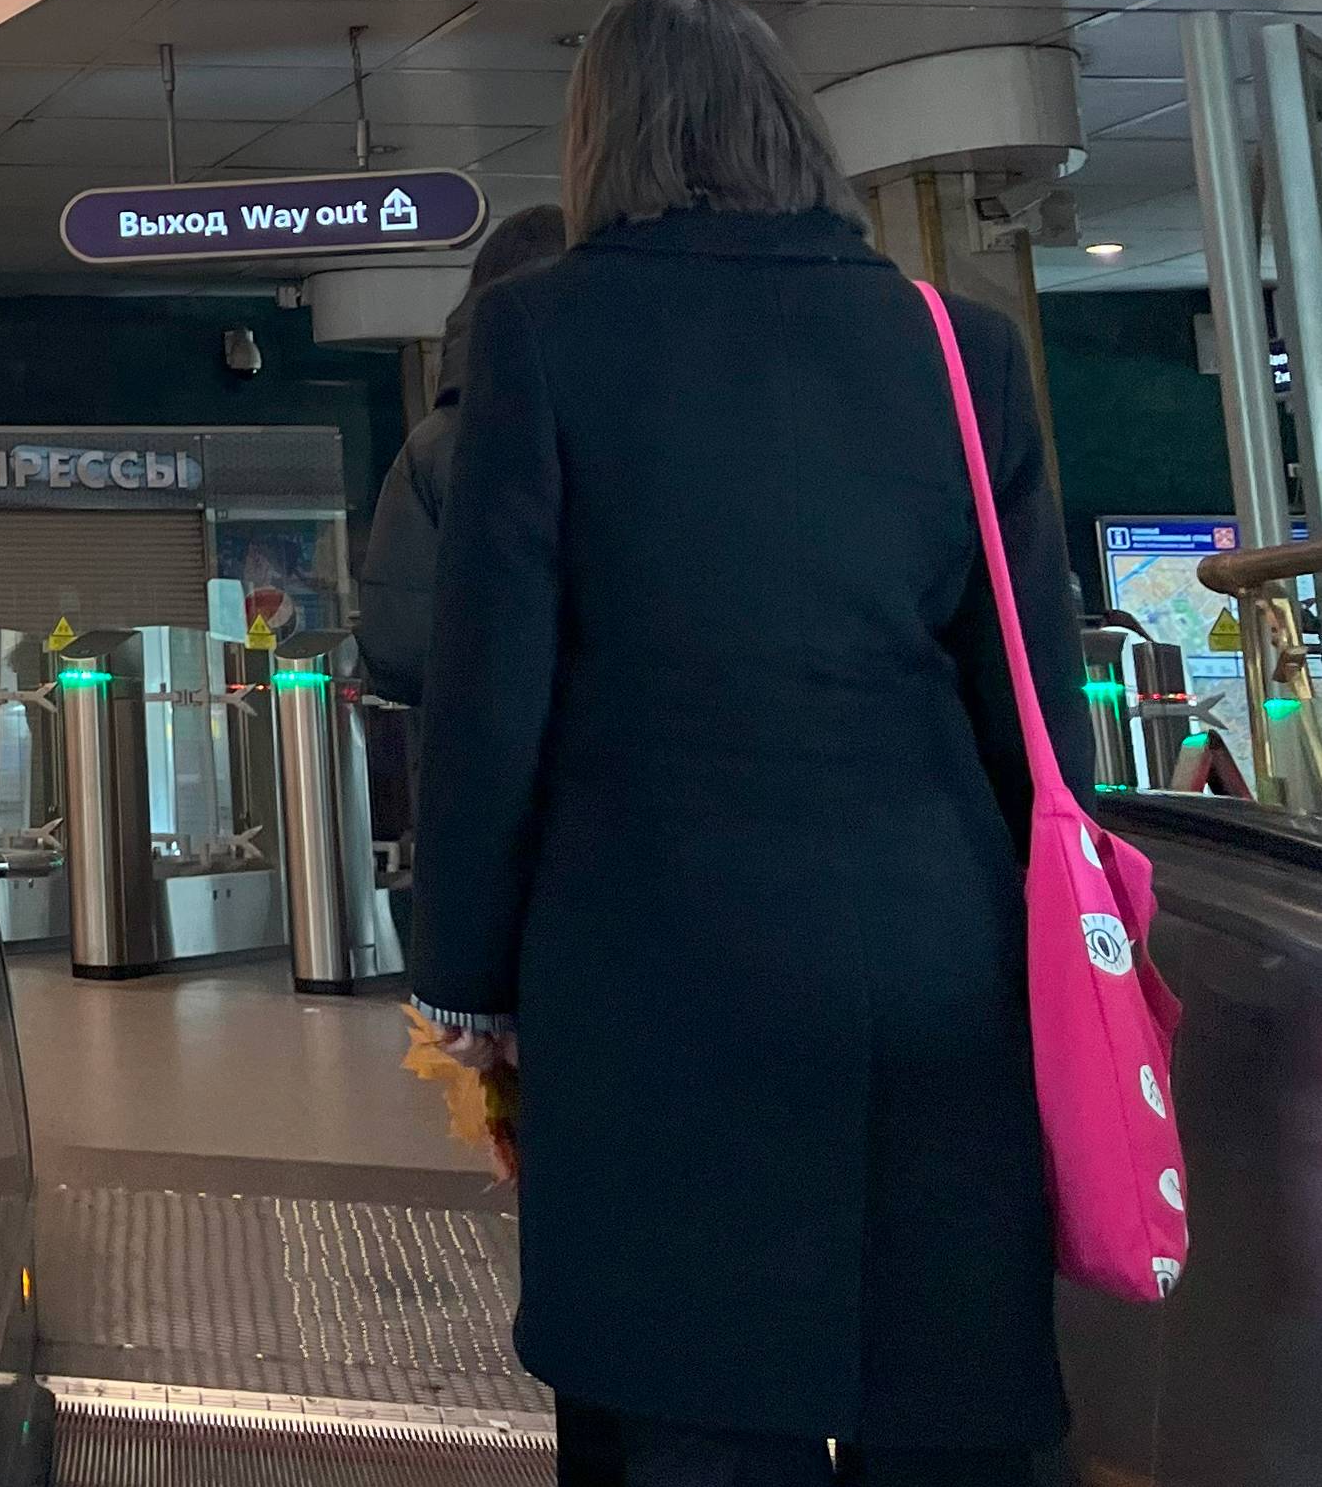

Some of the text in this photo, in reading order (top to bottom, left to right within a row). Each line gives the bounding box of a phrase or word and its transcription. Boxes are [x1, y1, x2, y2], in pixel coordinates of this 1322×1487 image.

[119, 200, 368, 237] Выход Way out
